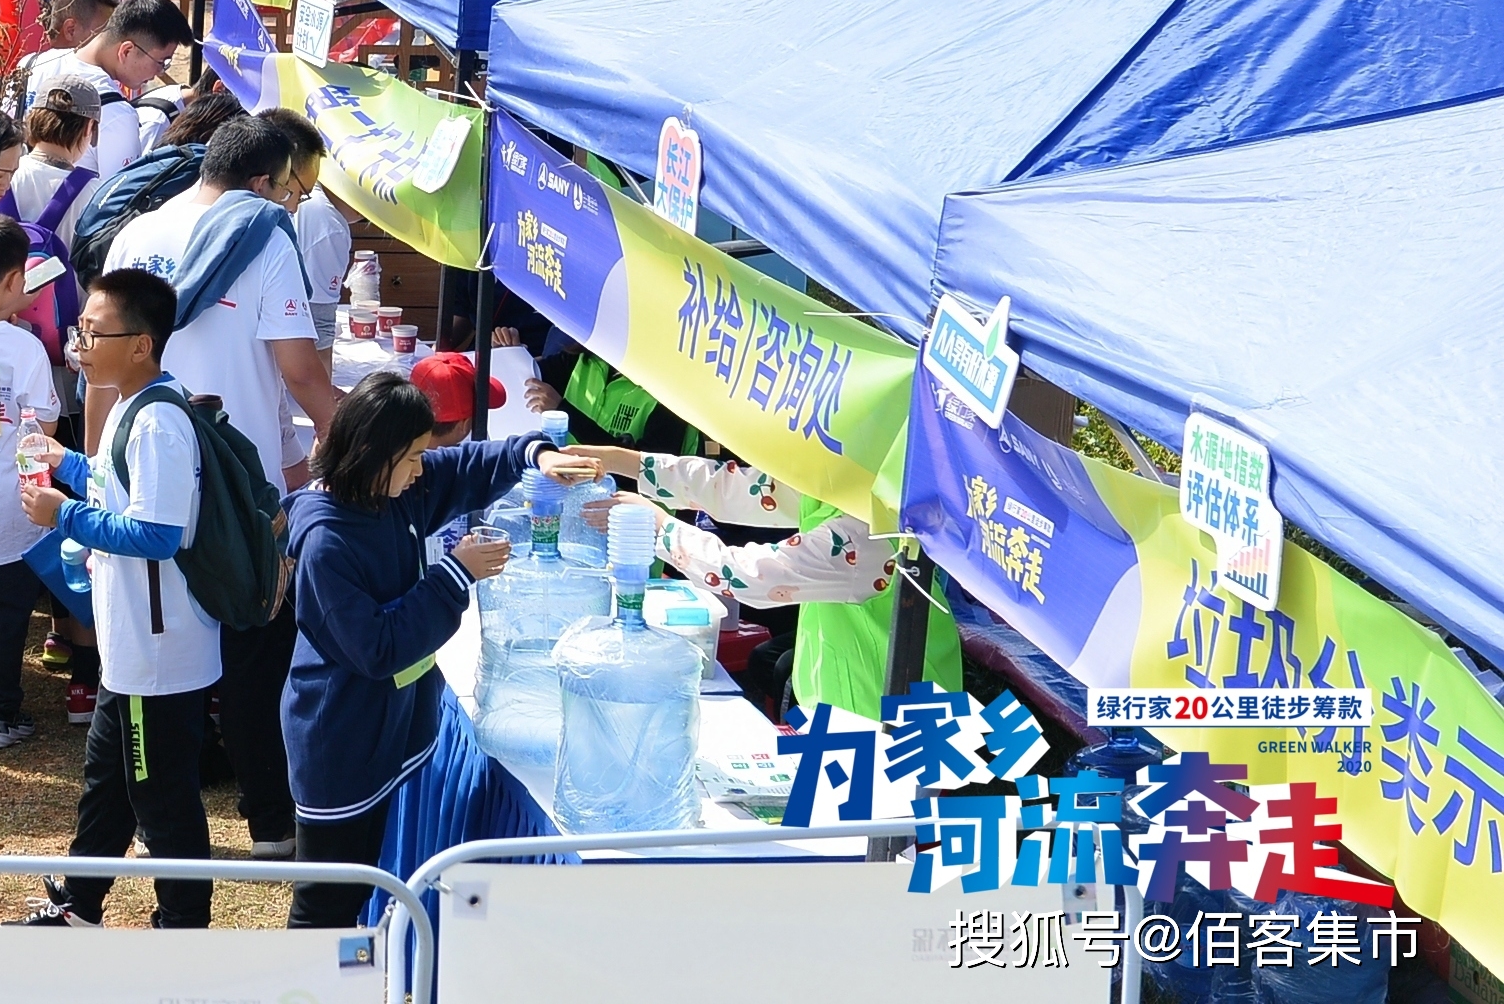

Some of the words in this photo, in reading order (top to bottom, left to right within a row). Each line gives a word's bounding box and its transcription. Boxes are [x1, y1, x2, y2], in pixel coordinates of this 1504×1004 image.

[547, 171, 571, 198] SANY
[666, 137, 692, 187] 长江
[518, 209, 539, 248] 为家乡
[656, 177, 694, 229] 大保护
[526, 243, 567, 300] 河流奔走
[677, 256, 853, 456] 补给/咨询处
[1190, 424, 1265, 493] 水源地指数
[1186, 469, 1259, 547] 评估体系
